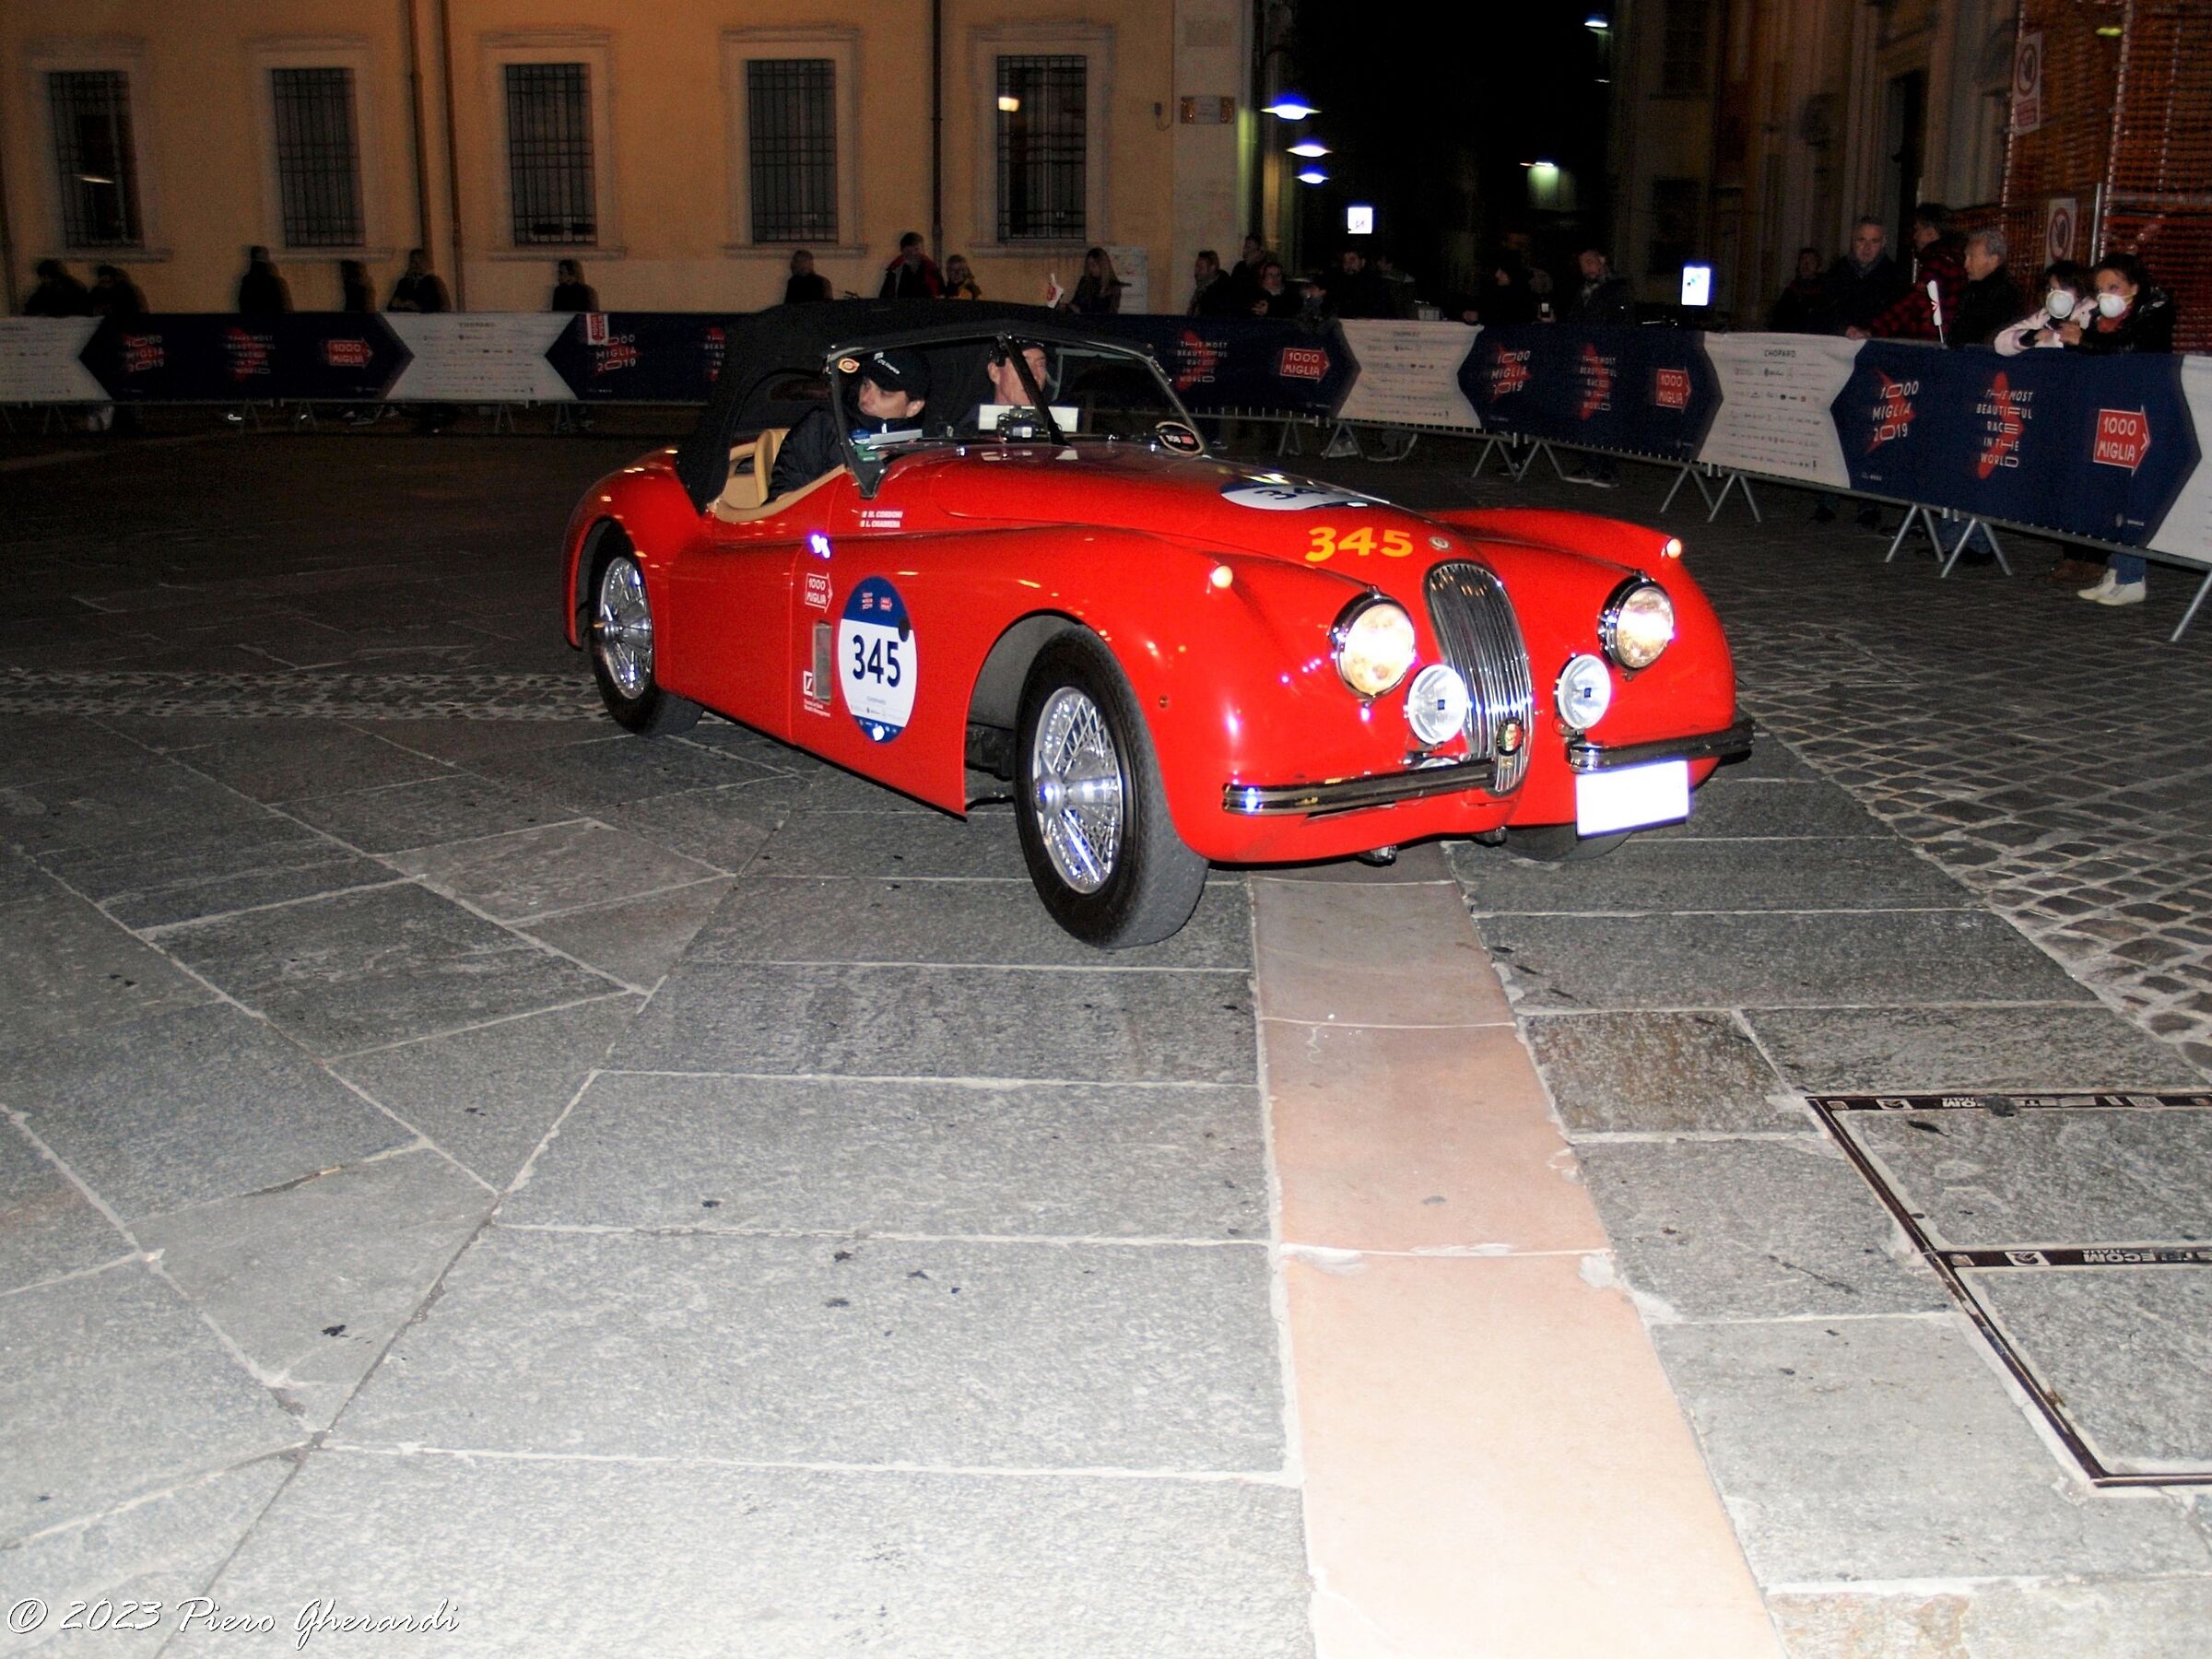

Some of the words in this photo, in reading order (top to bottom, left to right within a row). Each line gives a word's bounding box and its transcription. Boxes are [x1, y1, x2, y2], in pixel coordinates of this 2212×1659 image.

[334, 343, 362, 353] 1000
[595, 347, 638, 359] MIGLIA
[1288, 351, 1320, 363] 1000
[1497, 350, 1531, 364] 1000
[596, 359, 637, 372] 2019
[1282, 364, 1321, 377] MIGLIA
[1490, 366, 1528, 381] MIGLIA
[1660, 374, 1684, 388] 1000
[1879, 381, 1920, 400] 1000
[1984, 389, 2007, 399] THE
[2008, 390, 2034, 403] MOST
[1872, 403, 1912, 422] MIGLIA
[1975, 404, 2033, 420] BEAUTIFUL
[1873, 423, 1909, 442] 2019
[1986, 420, 2019, 435] RACE
[2103, 417, 2137, 437] 1000
[1983, 436, 1993, 447] IN
[1994, 438, 2020, 453] THE
[2097, 440, 2136, 462] MIGLIA
[1980, 453, 2019, 468] WORLD
[1304, 526, 1414, 562] 345
[808, 578, 827, 591] 1000
[806, 591, 828, 605] MIGLIA
[853, 635, 901, 688] 345
